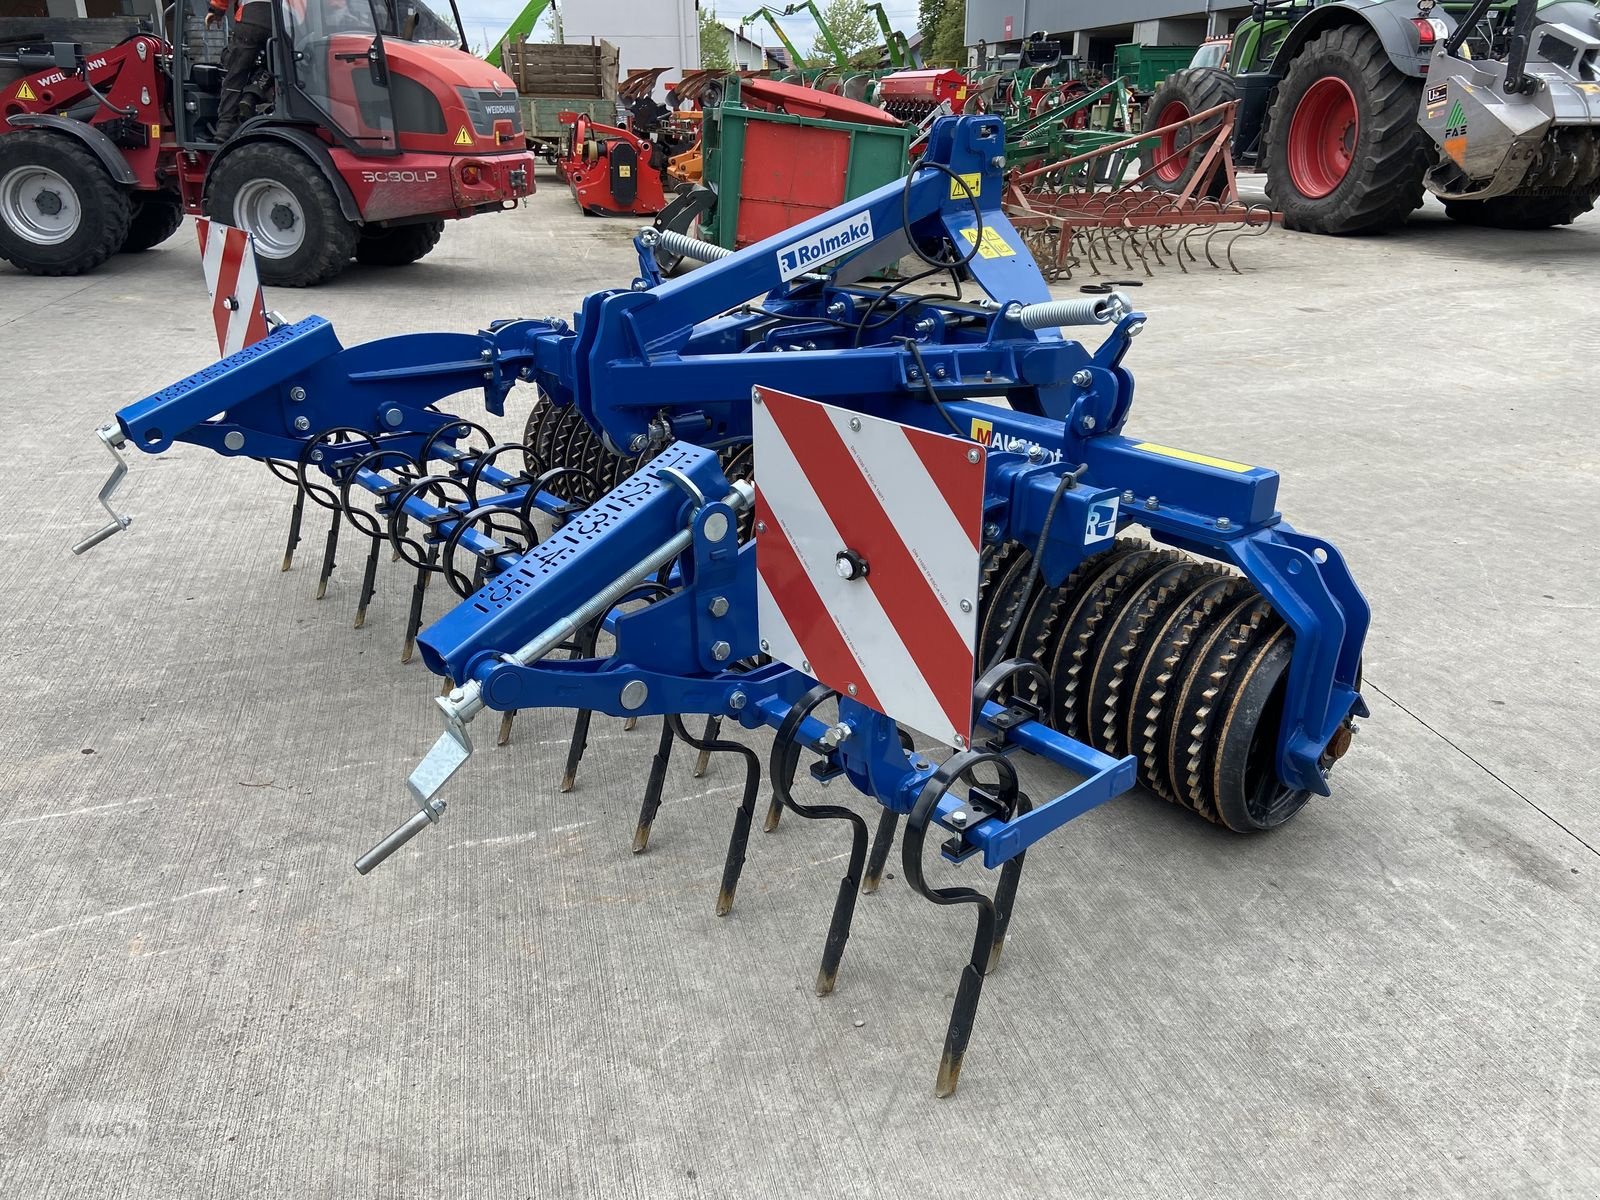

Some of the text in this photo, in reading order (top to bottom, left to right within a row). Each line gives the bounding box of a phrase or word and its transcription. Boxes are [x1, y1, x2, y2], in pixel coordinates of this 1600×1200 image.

[485, 105, 516, 115] WEIDEMANN
[1445, 125, 1467, 139] FAE
[797, 222, 870, 265] Rolmako
[617, 482, 650, 504] 2
[578, 513, 608, 534] 3
[538, 547, 568, 568] 4
[489, 578, 523, 602] 5
